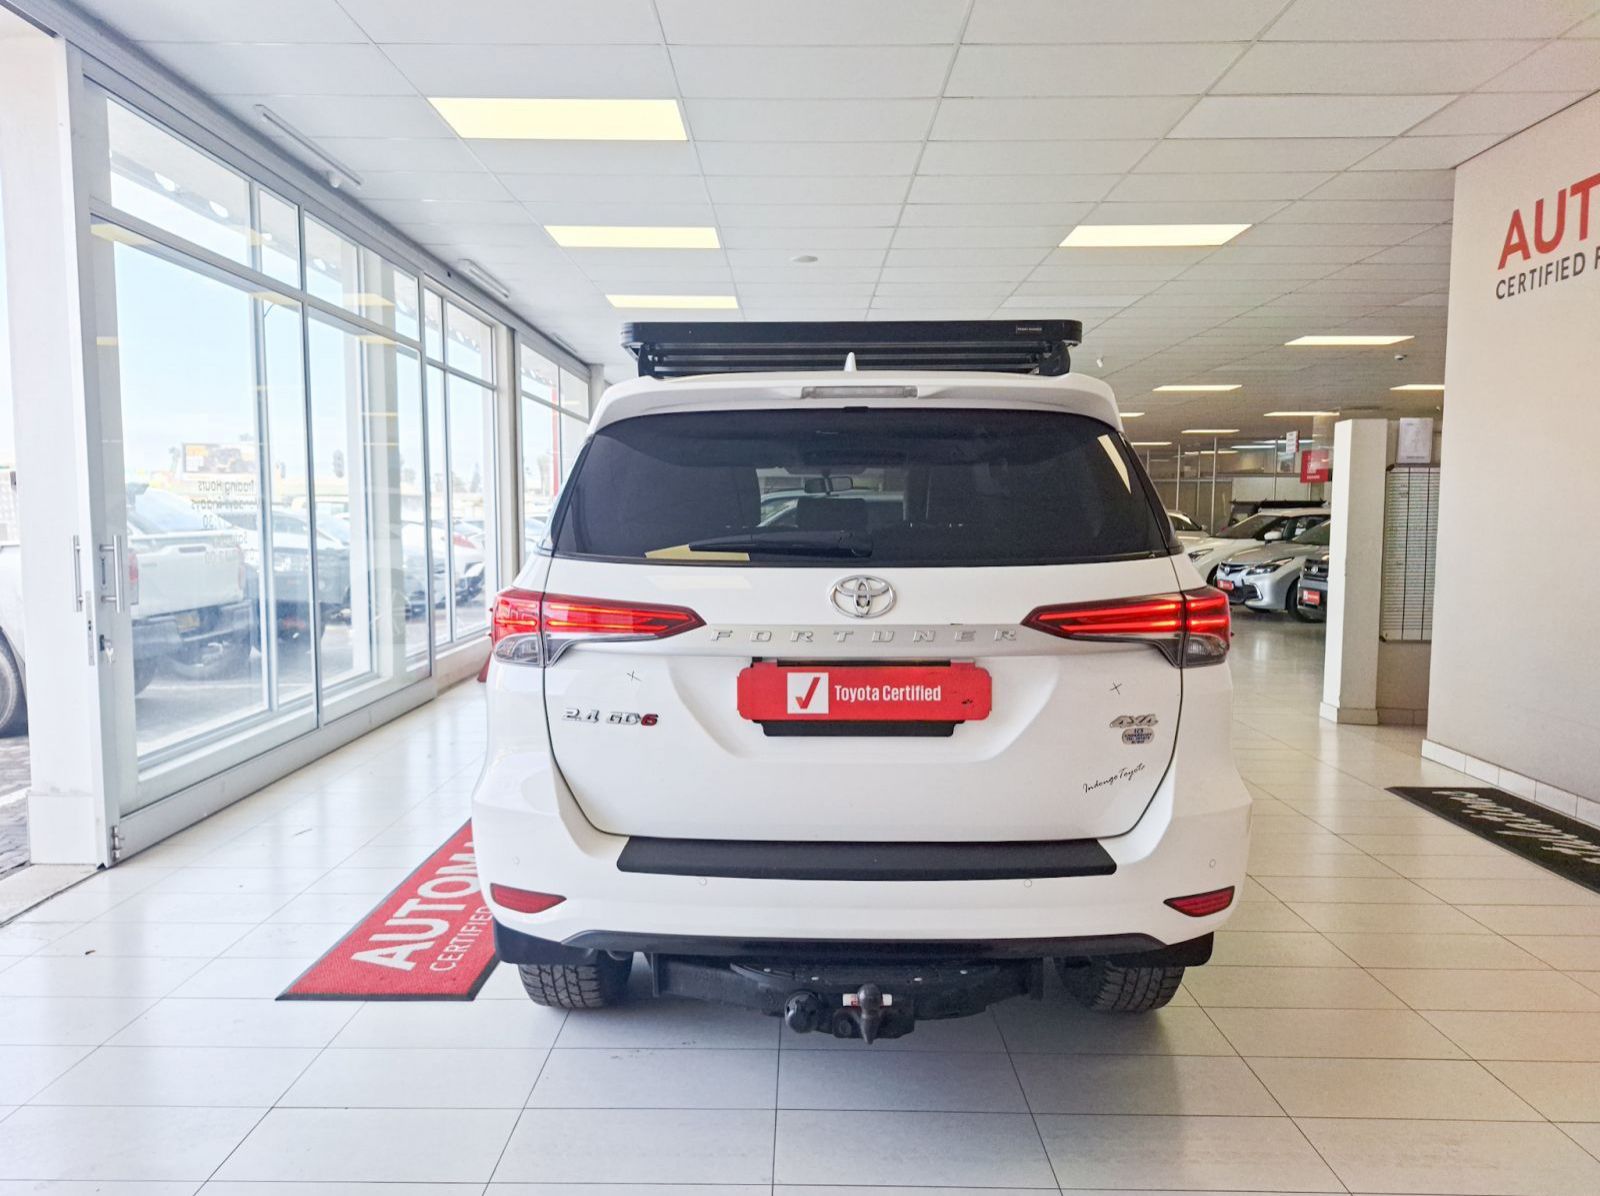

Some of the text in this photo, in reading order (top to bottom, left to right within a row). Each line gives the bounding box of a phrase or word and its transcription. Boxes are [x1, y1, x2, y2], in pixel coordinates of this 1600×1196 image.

[1495, 251, 1587, 300] CERTIFIED
[710, 629, 1018, 643] FORTUNER
[834, 684, 942, 703] Toyota Certified
[562, 707, 600, 724] 2.4
[1119, 762, 1146, 781] Toyota
[351, 840, 482, 972] AUTOM
